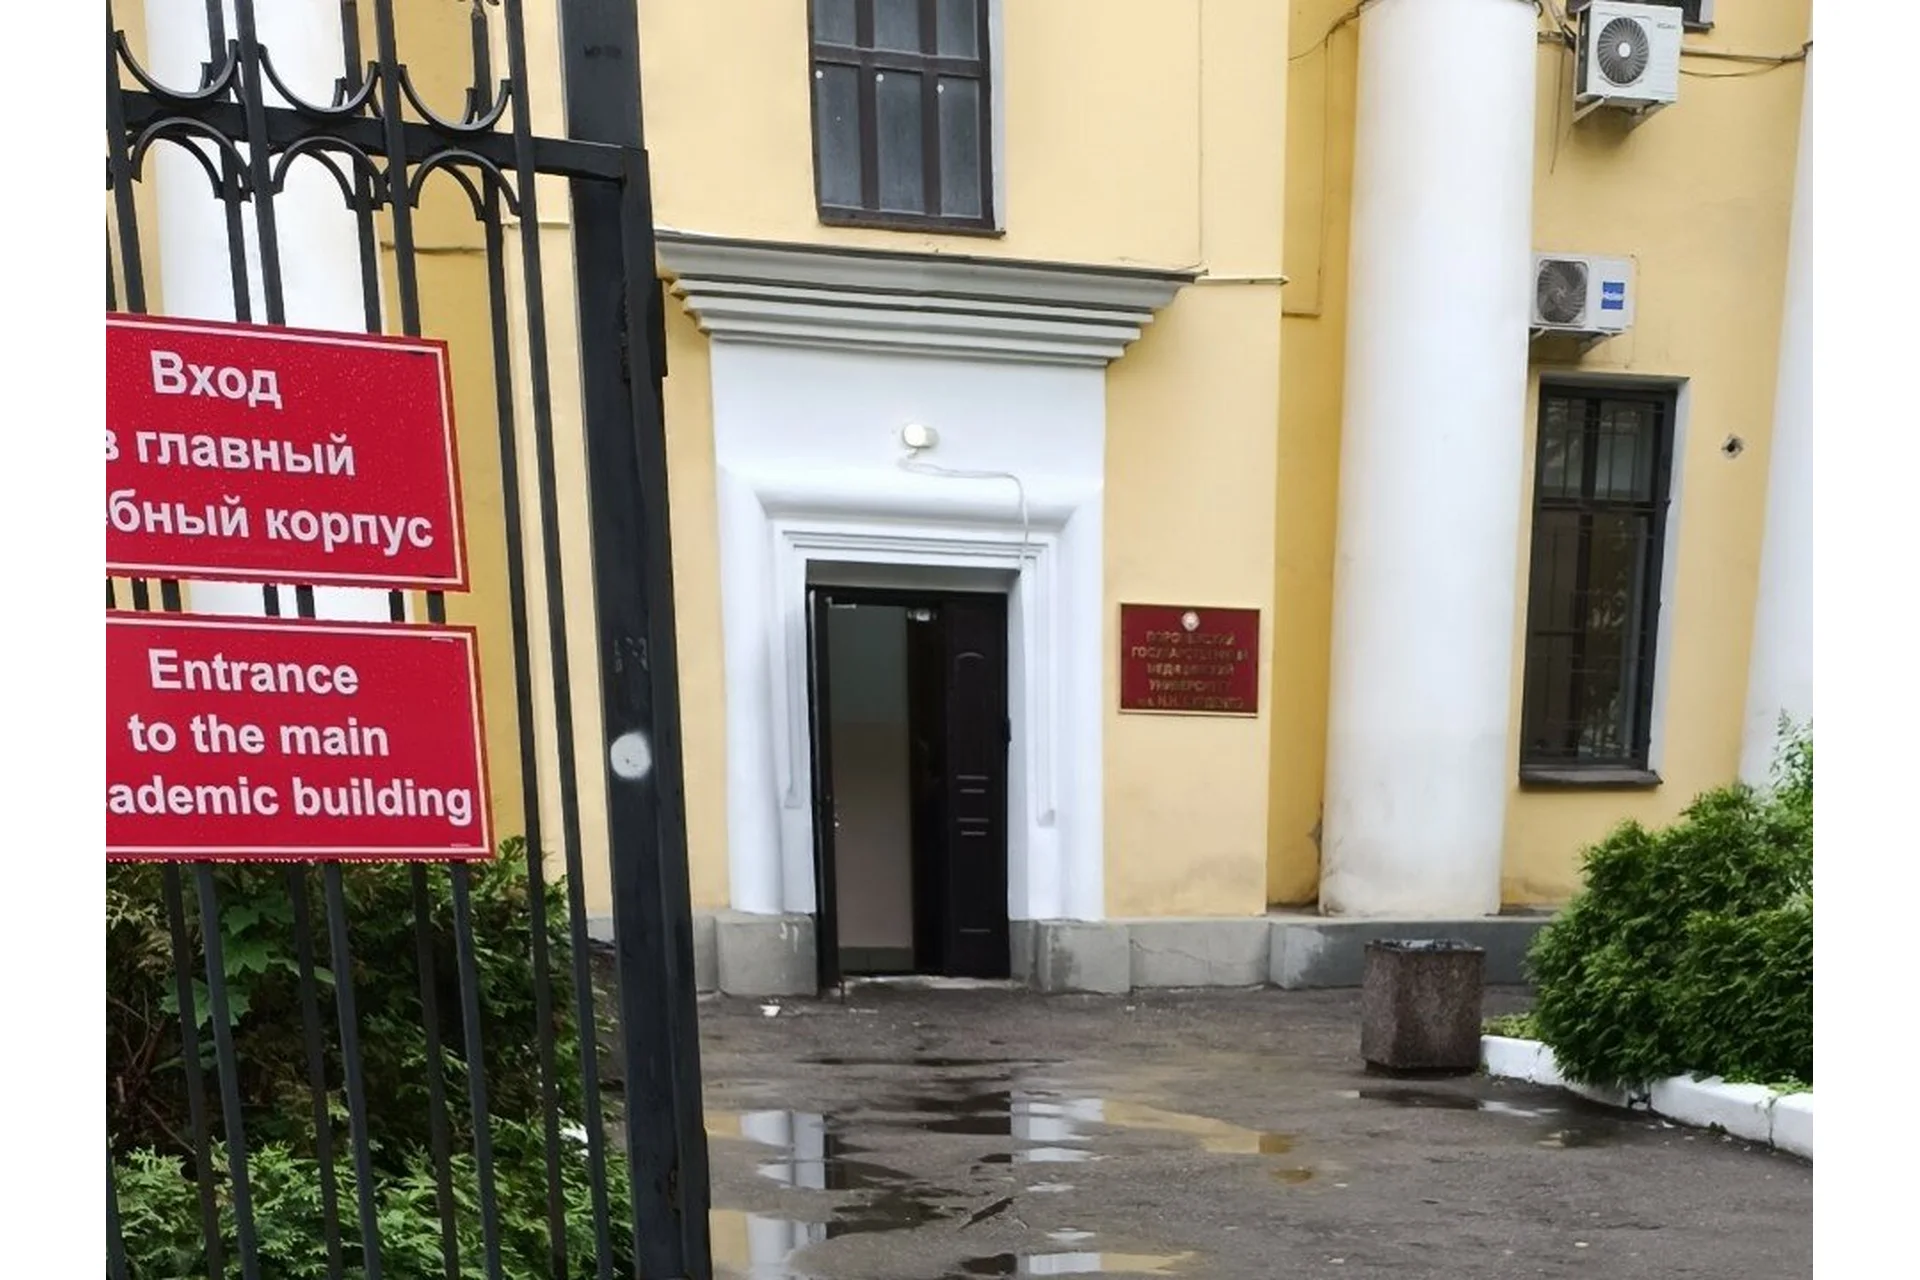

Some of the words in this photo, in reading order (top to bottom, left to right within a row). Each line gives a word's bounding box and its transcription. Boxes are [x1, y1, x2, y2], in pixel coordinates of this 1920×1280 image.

[149, 349, 283, 410] Вход
[135, 432, 356, 477] главный
[106, 488, 250, 538] бный
[264, 507, 435, 557] корпус
[148, 647, 359, 696] Entrance
[127, 712, 177, 753] to
[189, 713, 265, 755] the
[279, 717, 390, 757] main
[106, 774, 280, 816] ademic
[291, 776, 473, 828] building
